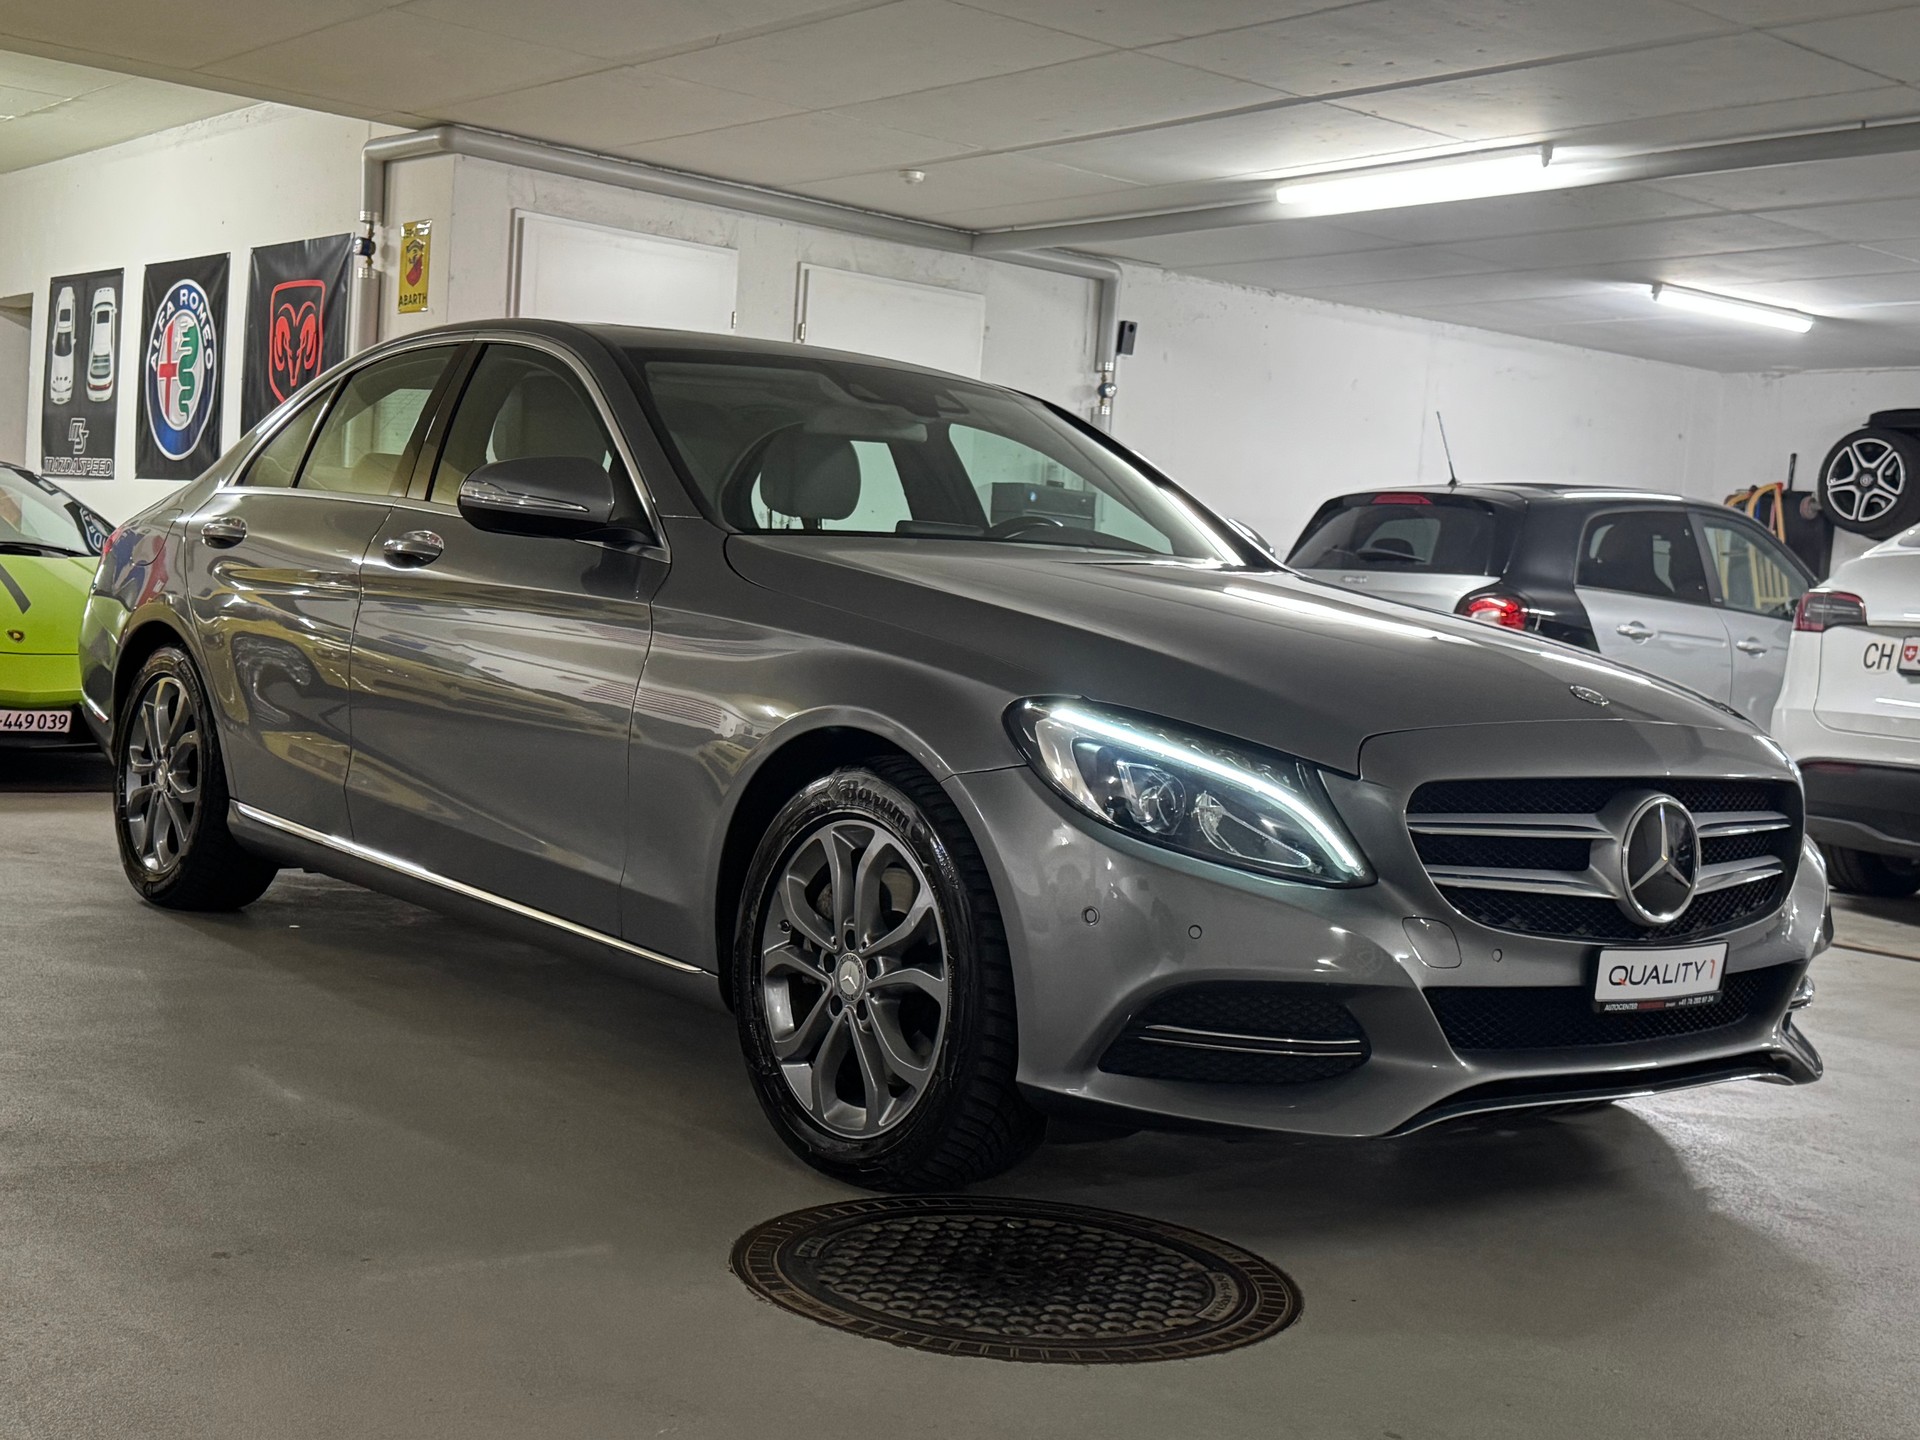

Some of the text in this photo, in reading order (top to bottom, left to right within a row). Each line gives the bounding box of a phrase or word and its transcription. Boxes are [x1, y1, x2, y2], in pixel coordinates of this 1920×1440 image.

[398, 292, 428, 306] ABARTH
[150, 289, 214, 372] ALFA ROMEO
[44, 457, 113, 476] MAZDASPEED
[1863, 642, 1896, 671] CH
[37, 713, 68, 730] 039
[838, 780, 911, 833] Barum
[1608, 960, 1707, 987] QUALITY
[1604, 1002, 1639, 1011] AUTOCENTER
